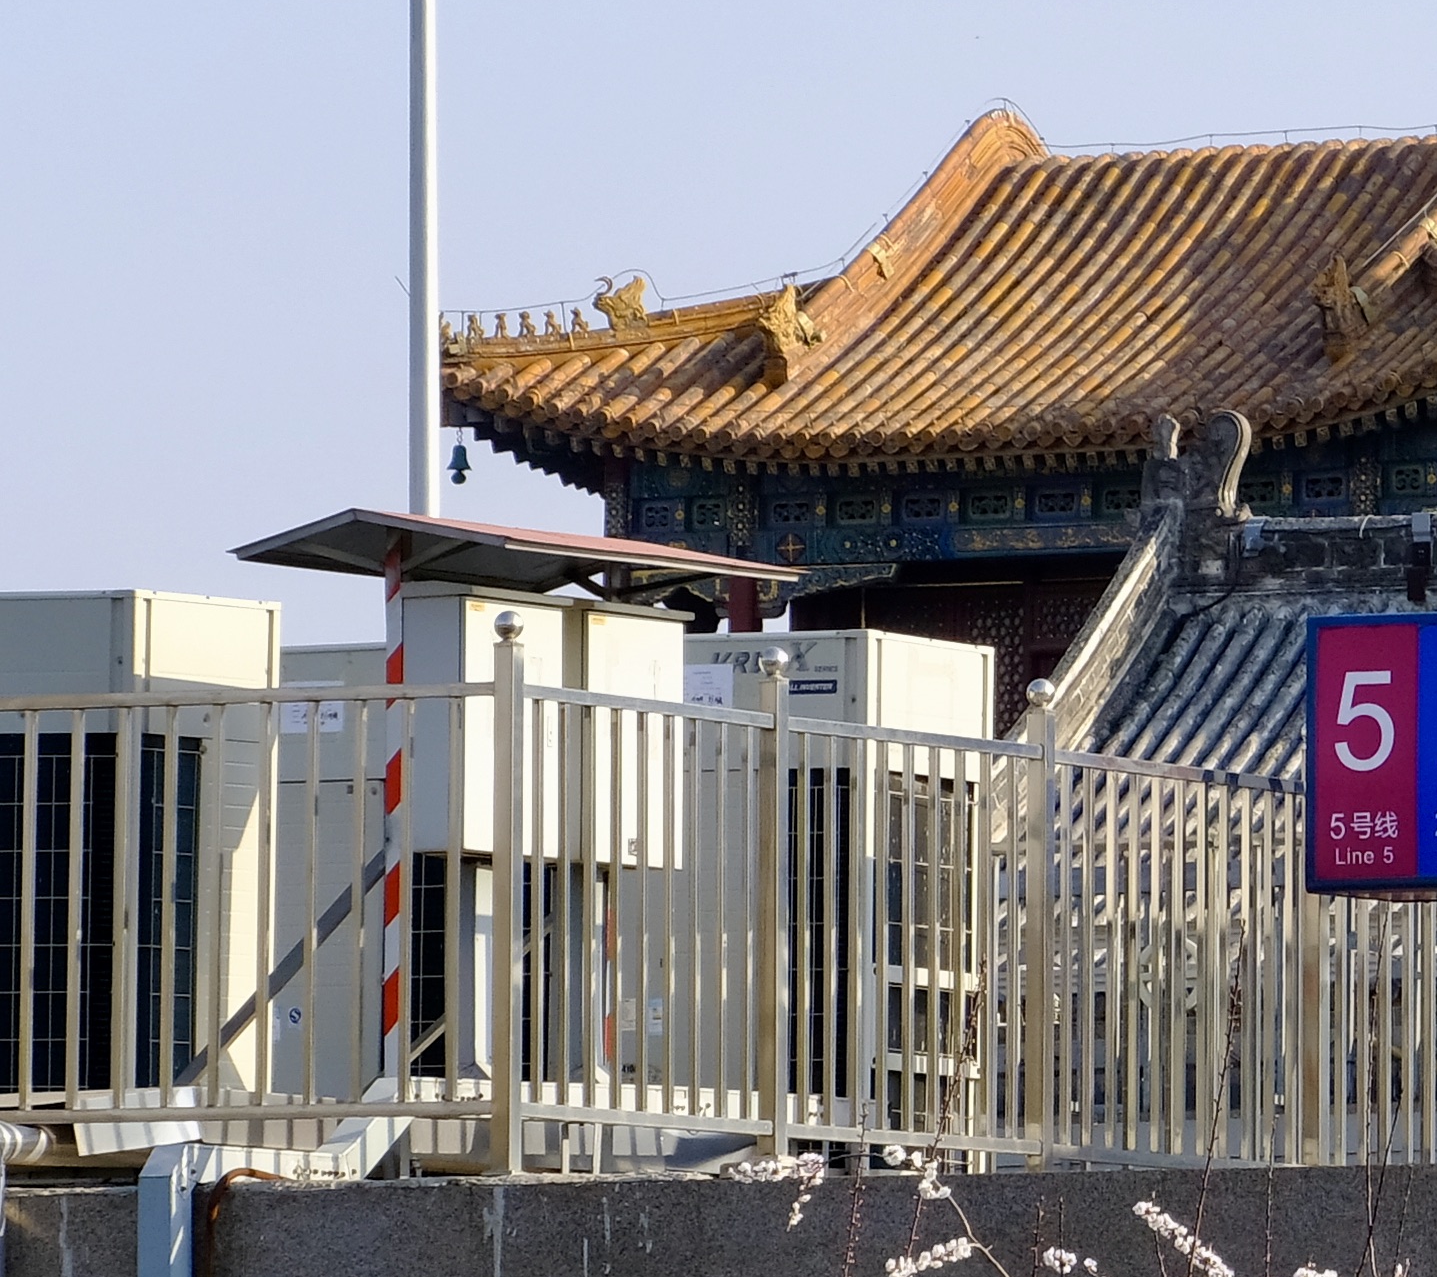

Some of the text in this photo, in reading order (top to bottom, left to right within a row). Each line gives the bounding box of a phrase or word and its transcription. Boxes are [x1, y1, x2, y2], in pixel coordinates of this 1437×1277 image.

[1334, 670, 1395, 772] 5
[1329, 811, 1398, 839] 5号线
[1335, 846, 1394, 865] Line 5
